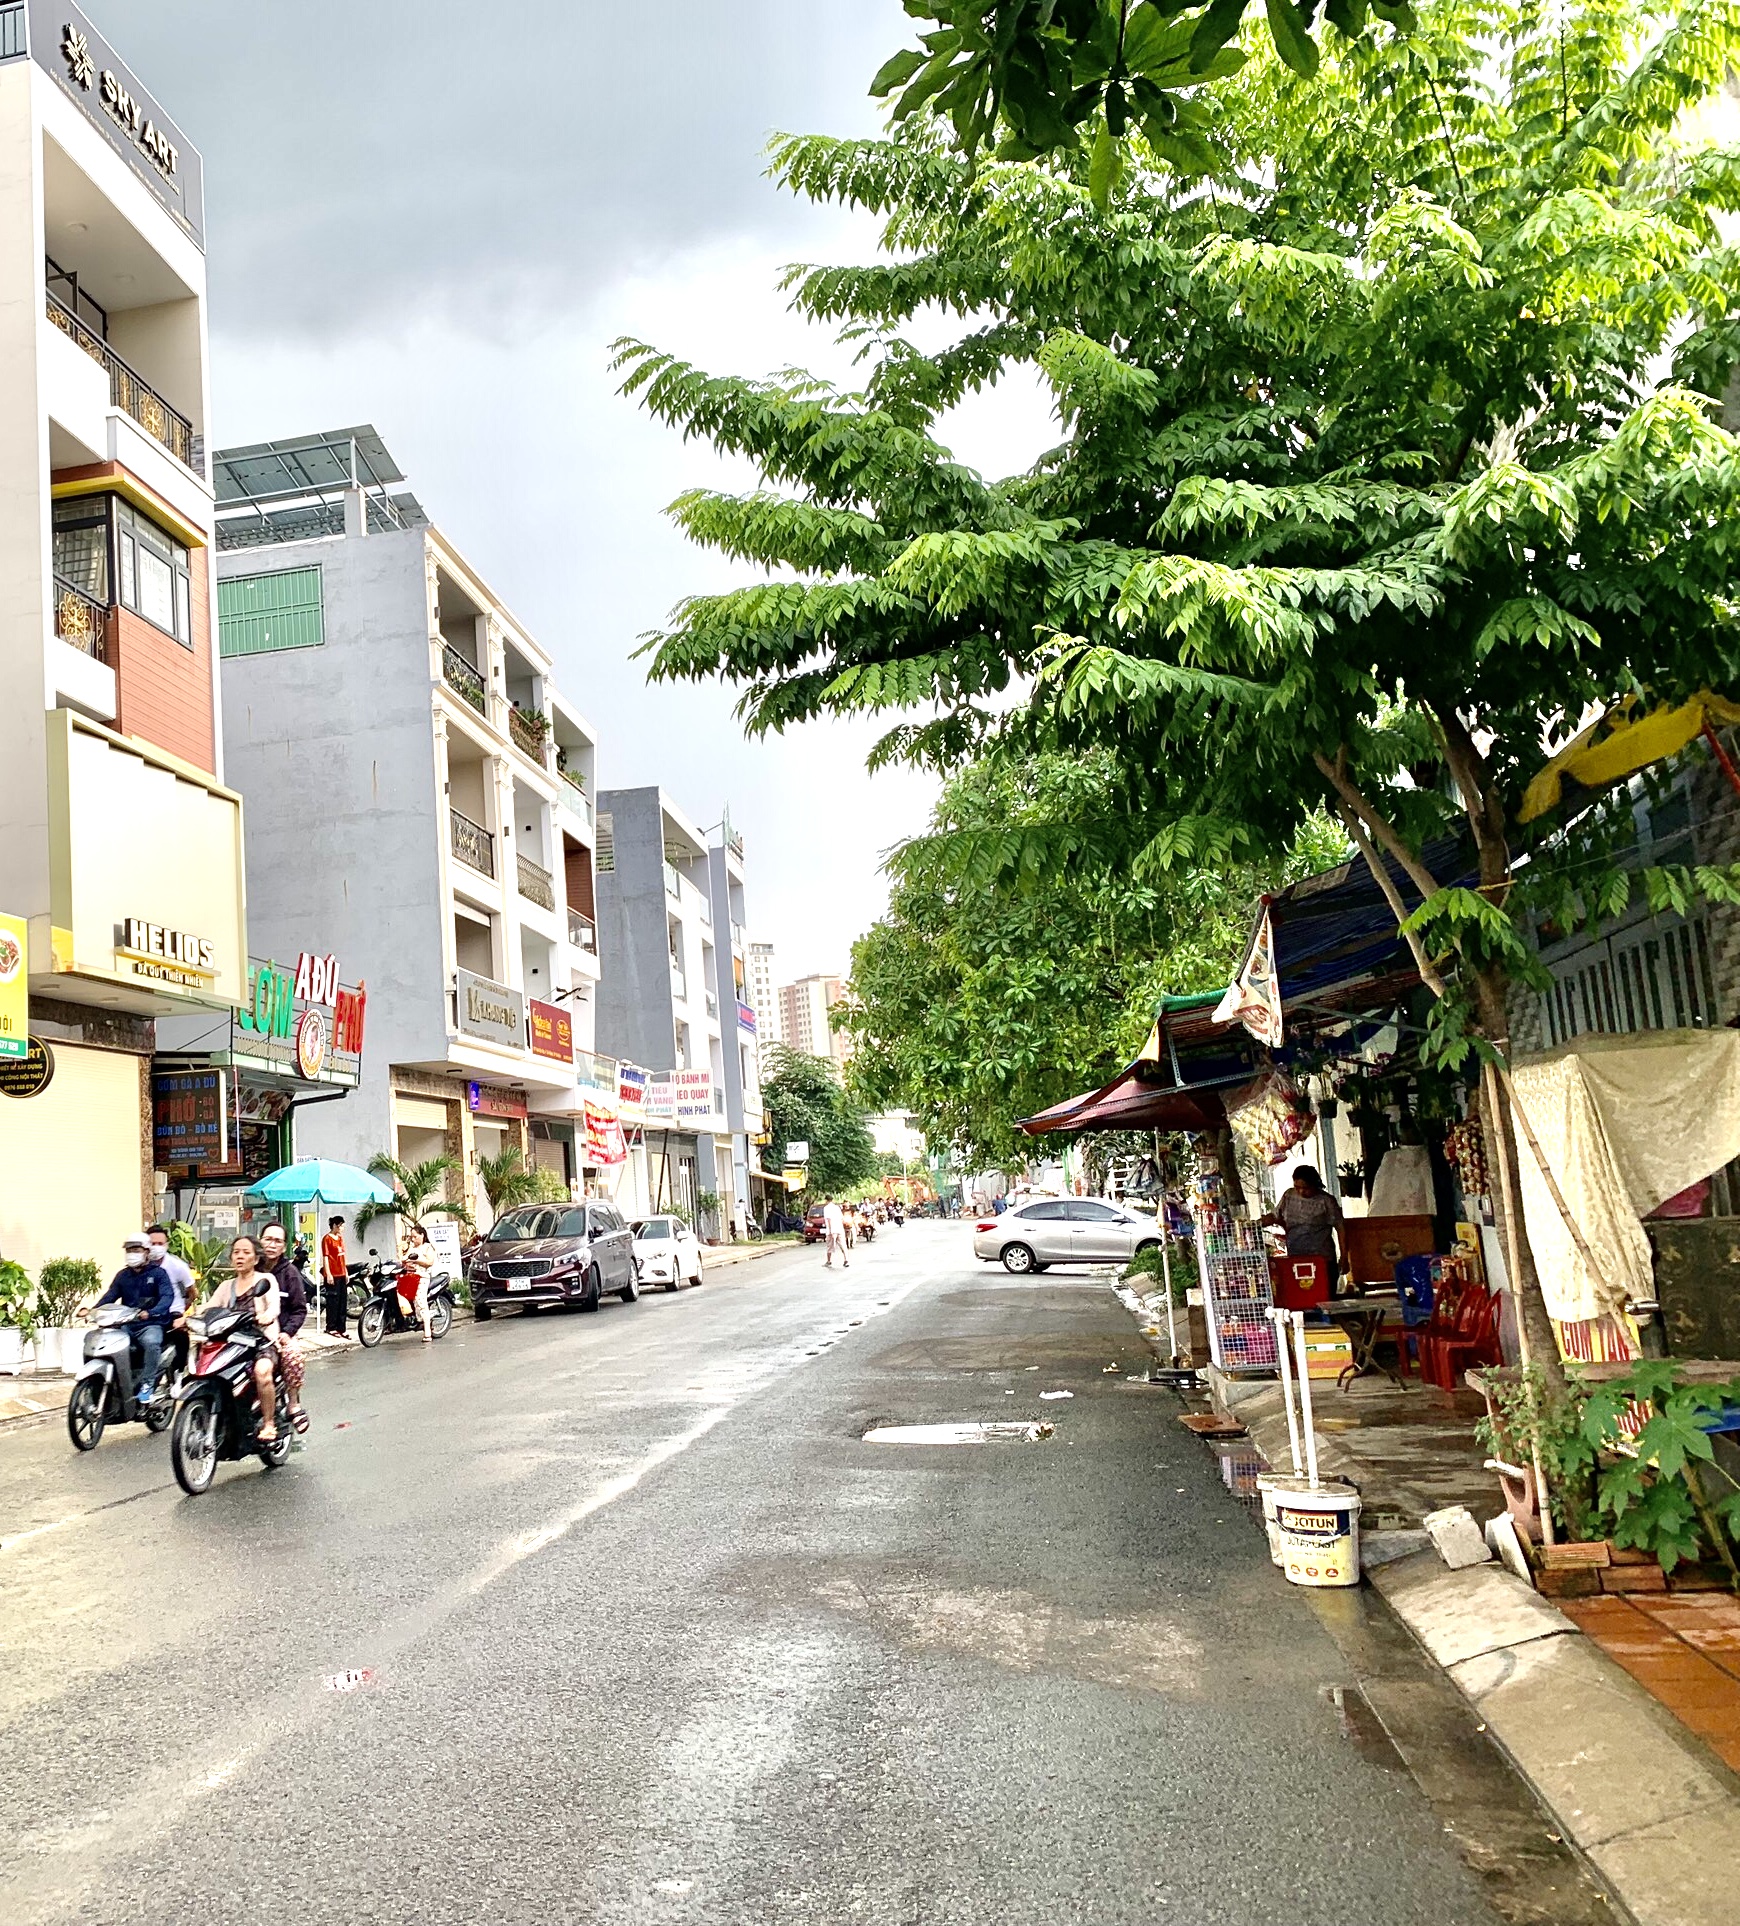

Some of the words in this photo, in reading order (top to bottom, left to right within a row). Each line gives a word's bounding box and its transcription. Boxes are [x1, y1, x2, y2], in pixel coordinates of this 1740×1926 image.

[143, 119, 179, 174] ART
[125, 918, 215, 969] HELIOS
[0, 1014, 12, 1034] ỘI
[28, 1048, 42, 1058] RT
[690, 1089, 709, 1101] QUAY
